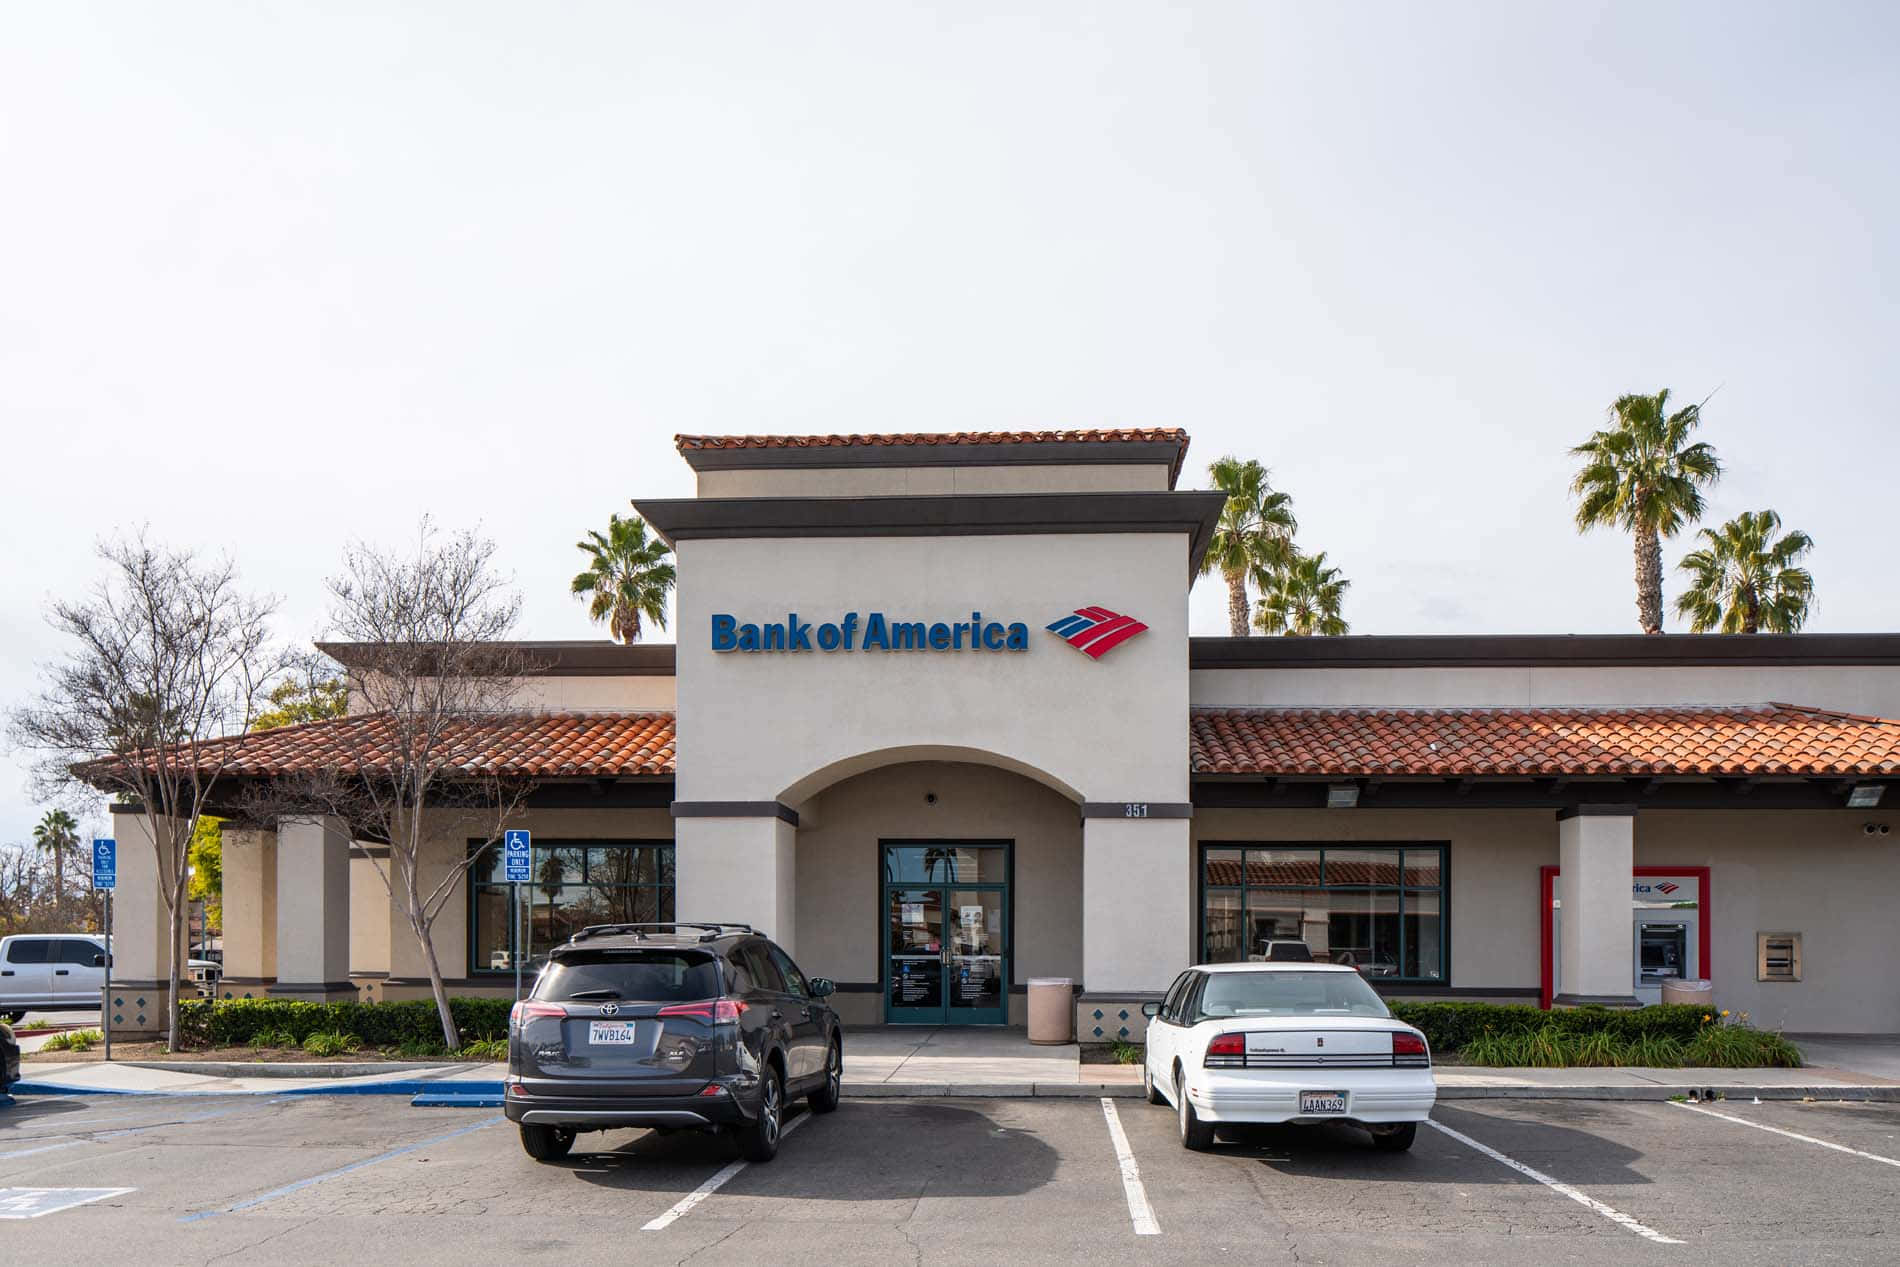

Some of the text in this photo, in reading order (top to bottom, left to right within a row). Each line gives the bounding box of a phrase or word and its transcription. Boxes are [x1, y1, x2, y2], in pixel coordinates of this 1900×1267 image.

[711, 611, 1029, 651] Bank of America
[1126, 804, 1147, 817] 351
[507, 850, 529, 858] PARKING
[1633, 883, 1651, 893] rica
[593, 1029, 631, 1041] 7WVB164
